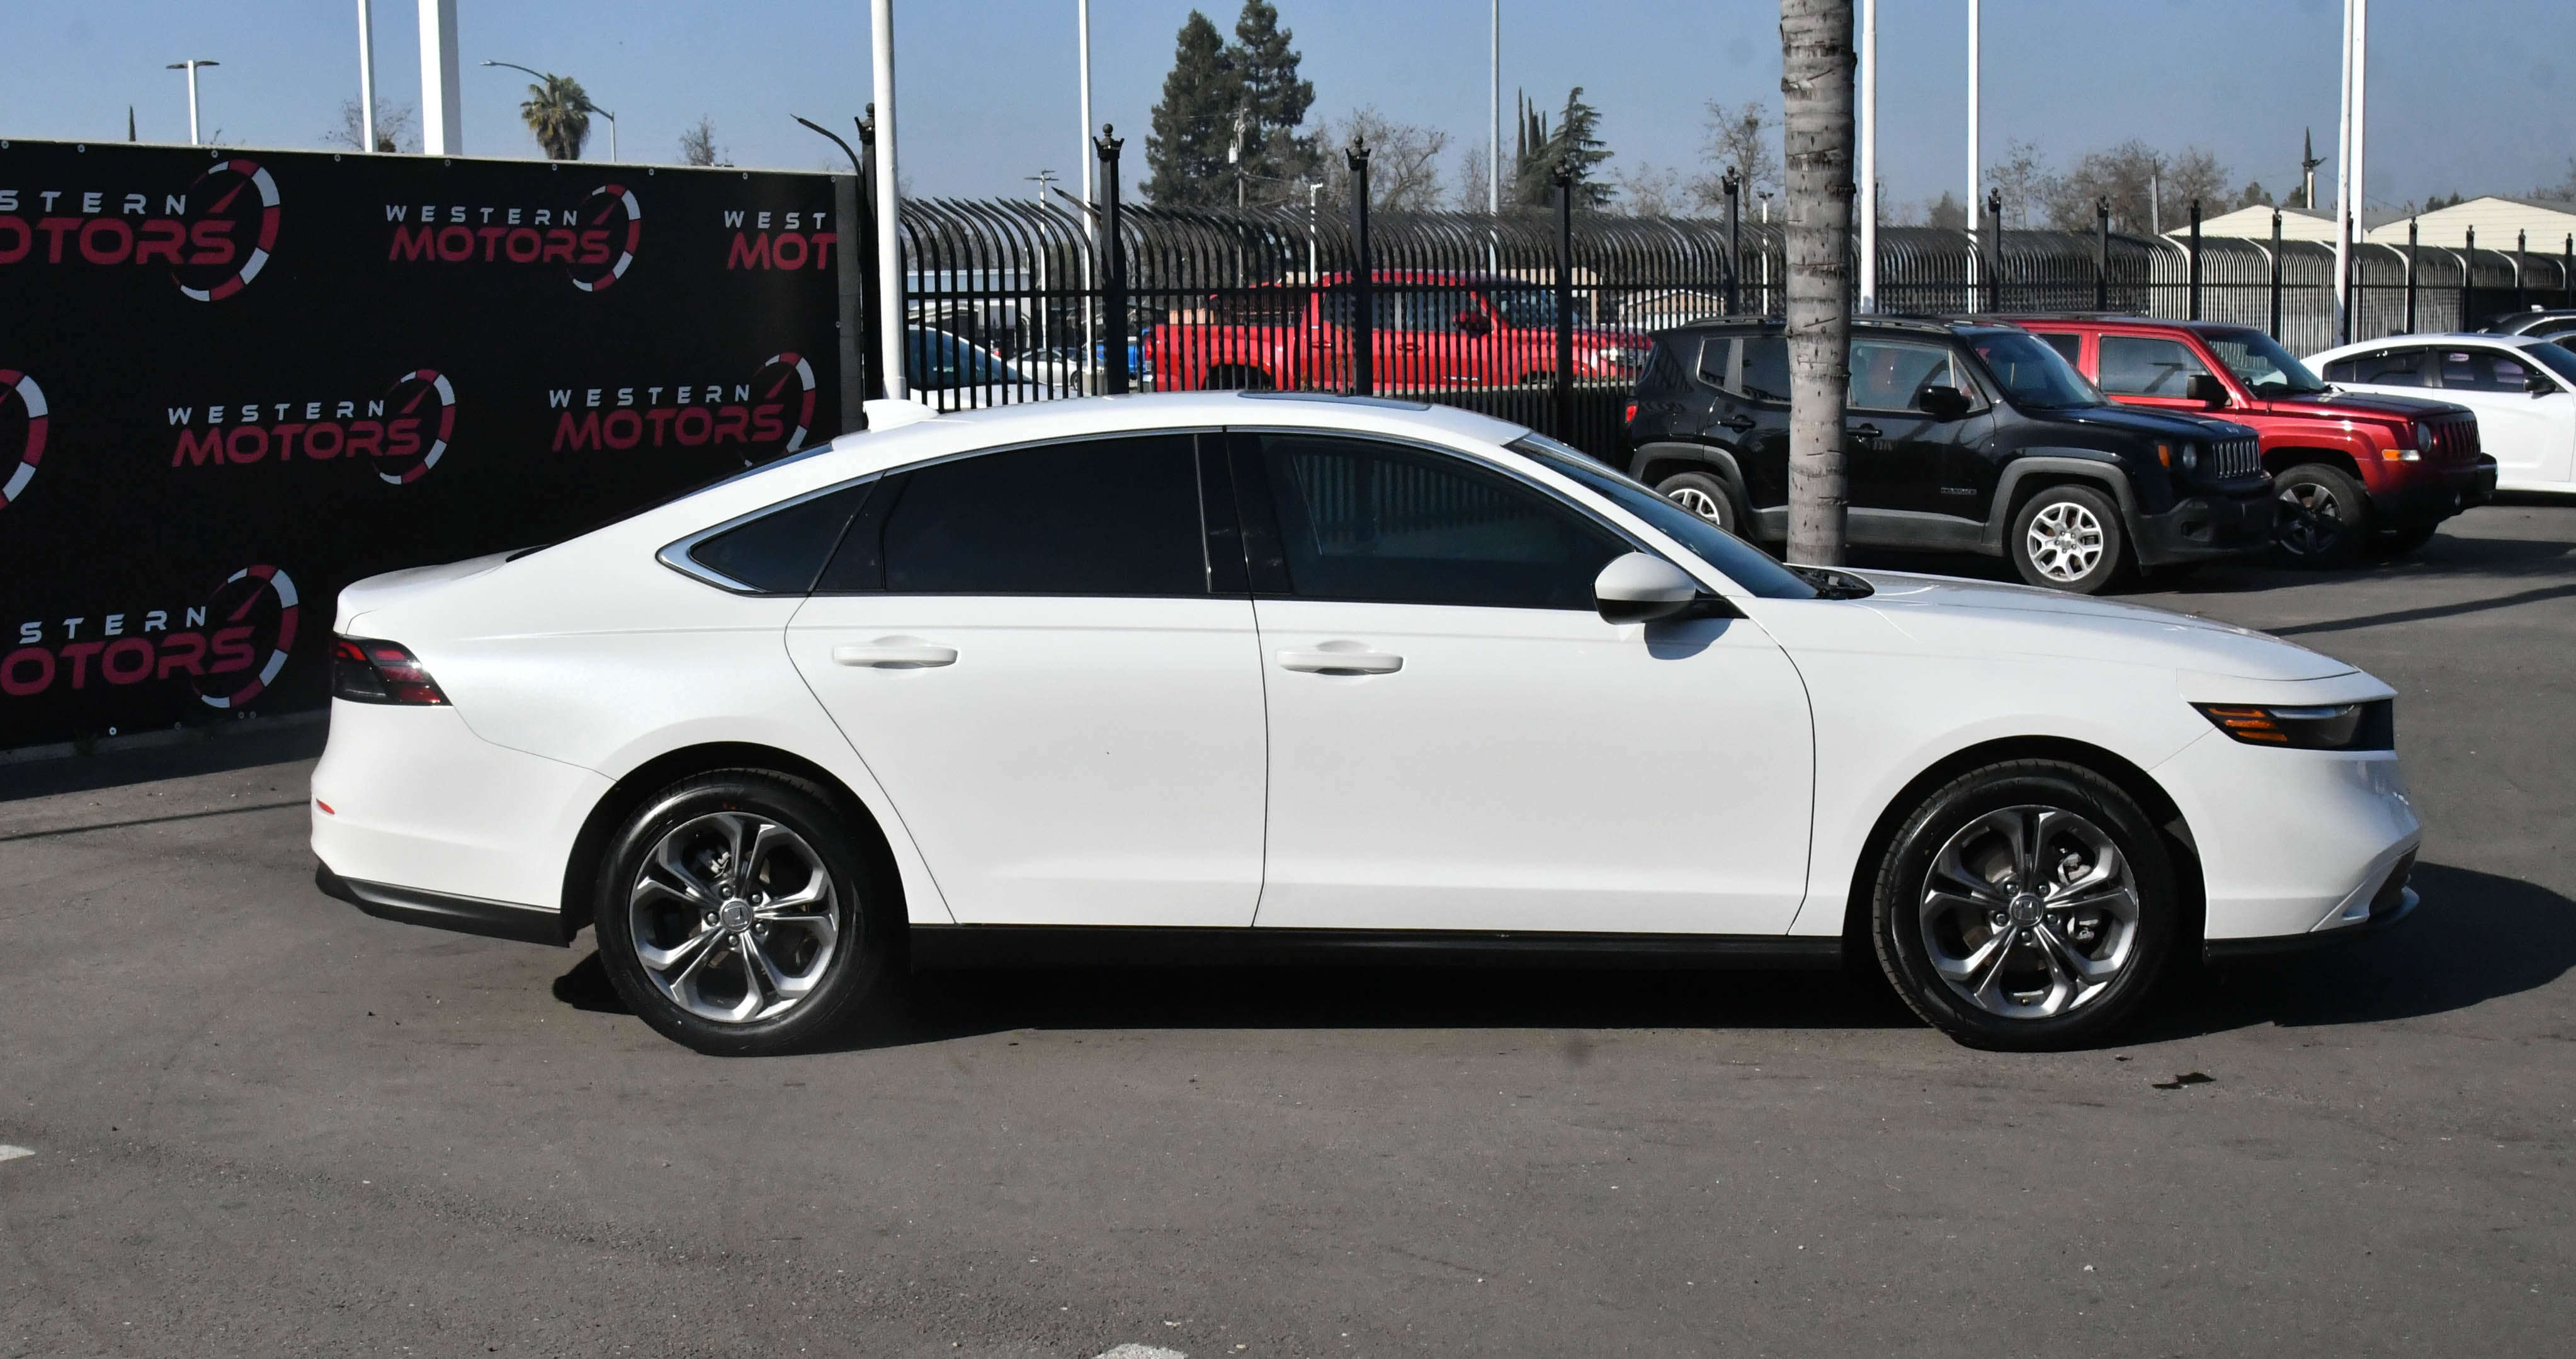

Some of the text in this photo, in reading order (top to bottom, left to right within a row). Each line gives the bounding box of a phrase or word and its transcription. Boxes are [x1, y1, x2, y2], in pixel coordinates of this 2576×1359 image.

[0, 190, 186, 215] STERN
[385, 205, 577, 226] WESTERN
[724, 210, 826, 229] WEST
[389, 225, 611, 264] MOTORS
[727, 232, 837, 271] MOT
[168, 400, 384, 425] WESTERN
[549, 384, 749, 408] WESTERN
[172, 418, 421, 467] MOTORS
[552, 404, 785, 452] MOTORS
[19, 606, 206, 644] STERN
[0, 625, 255, 696] OTORS
